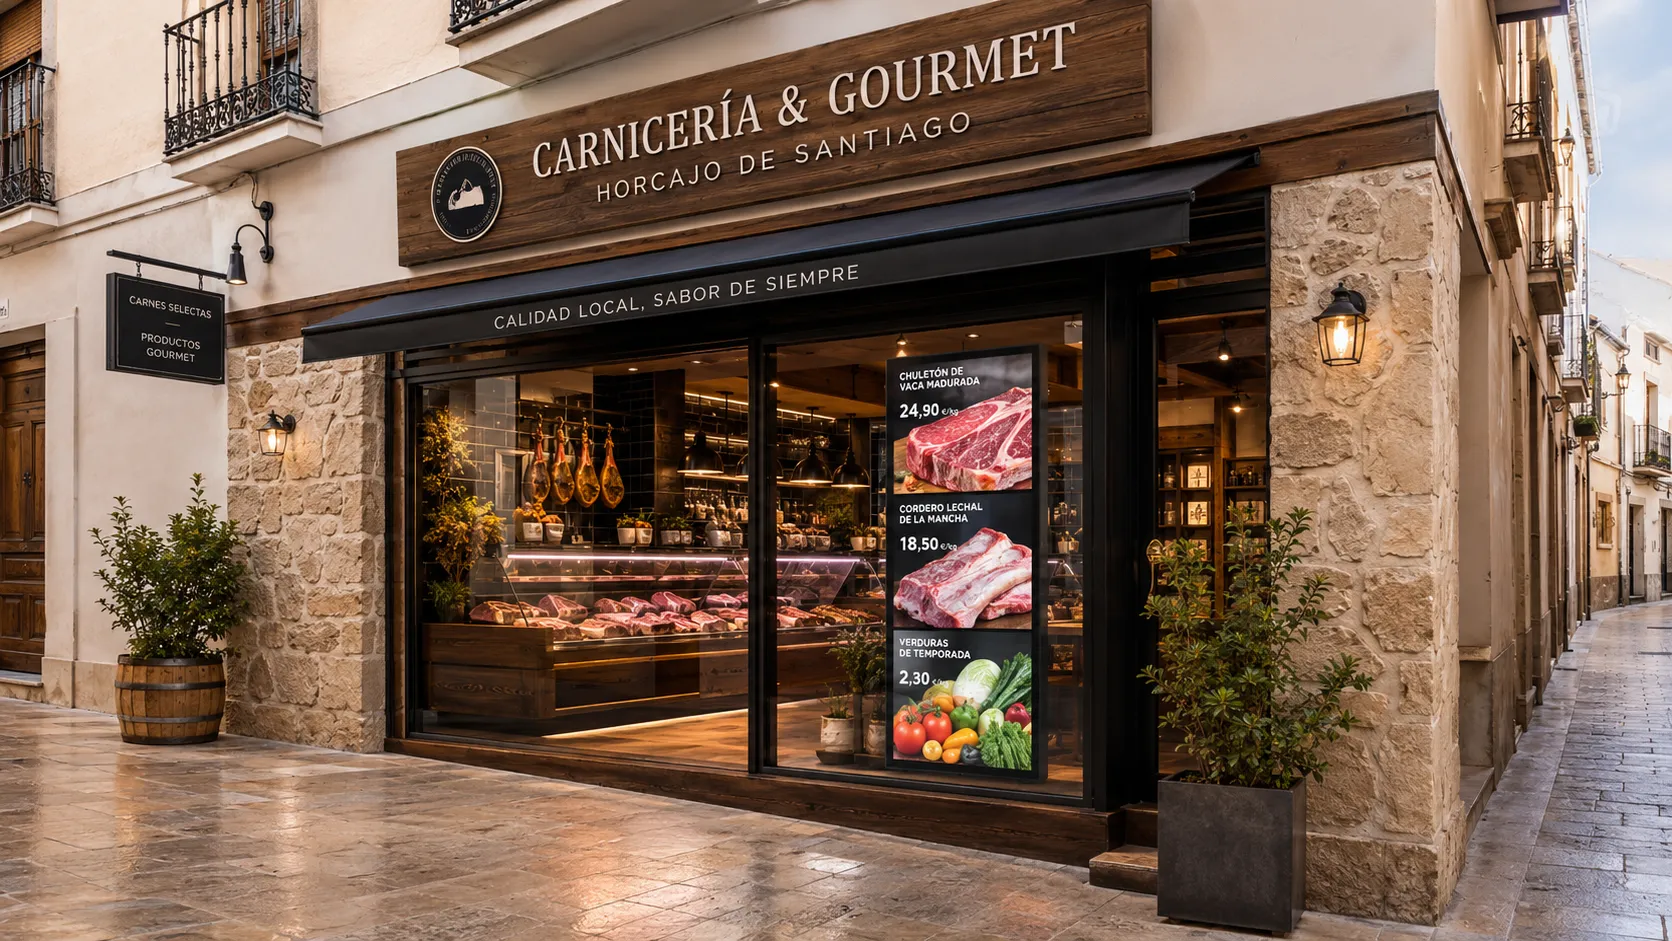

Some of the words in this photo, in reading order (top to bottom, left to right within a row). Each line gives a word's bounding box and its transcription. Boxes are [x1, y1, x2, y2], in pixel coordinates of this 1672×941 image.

[532, 88, 763, 178] CARNICERÍA
[778, 84, 809, 127] &
[828, 21, 1076, 116] GOURMET
[597, 161, 721, 203] HORCAJO
[740, 149, 775, 175] DE
[795, 111, 971, 163] SANTIAGO
[494, 306, 571, 330] CALIDAD
[579, 297, 645, 318] LOCAL,
[654, 285, 720, 307] SABOR
[730, 279, 756, 297] DE
[766, 264, 859, 291] SIEMPRE
[129, 295, 166, 310] CARNES
[168, 303, 212, 319] SELECTAS
[141, 333, 201, 350] PRODUCTOS
[146, 347, 195, 363] GOURMET
[899, 366, 949, 381] CHULETÓN
[951, 366, 964, 376] DE
[899, 381, 924, 392] VACA
[926, 376, 980, 389] MADURADA
[899, 402, 940, 420] 24,90
[899, 503, 944, 514] CORDERO
[946, 502, 983, 512] LECHAL
[899, 515, 912, 524] DE
[914, 515, 925, 524] LA
[927, 513, 969, 523] MANCHA
[899, 536, 939, 553] 18,50
[899, 638, 949, 648] VERDURAS
[899, 648, 912, 658] DE
[913, 649, 971, 660] TEMPORADA
[899, 669, 930, 687] 2,30
